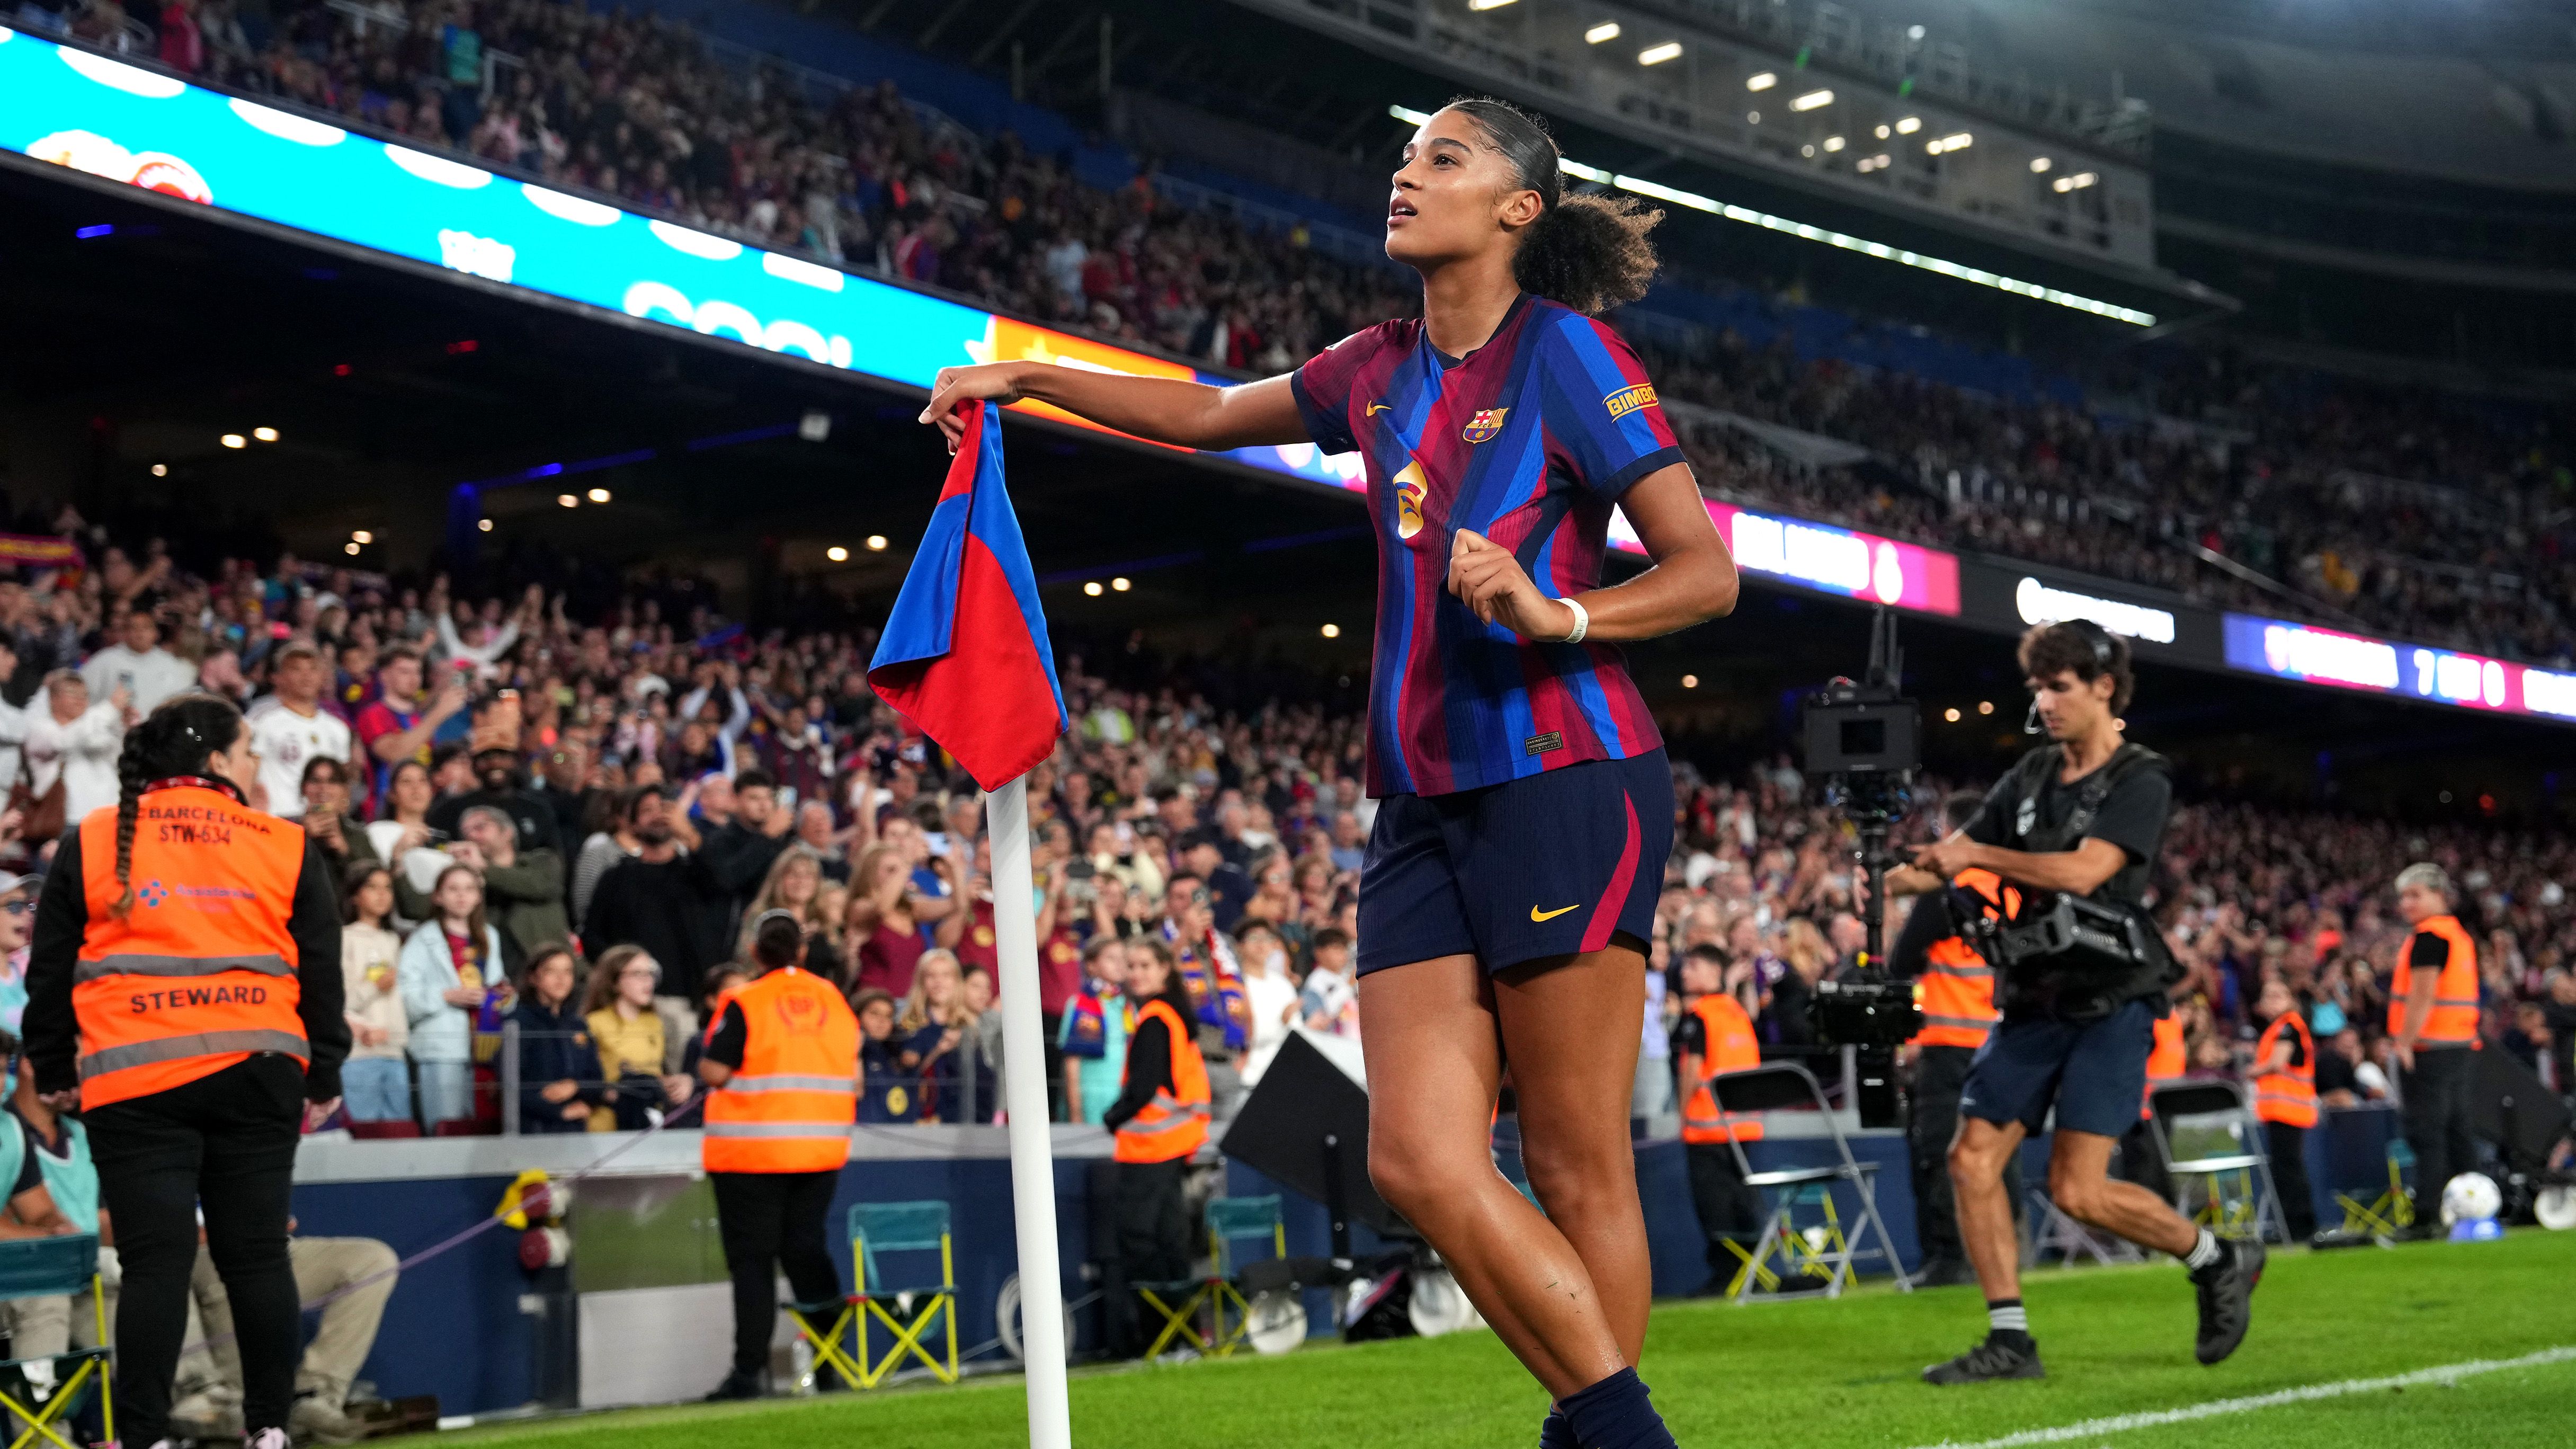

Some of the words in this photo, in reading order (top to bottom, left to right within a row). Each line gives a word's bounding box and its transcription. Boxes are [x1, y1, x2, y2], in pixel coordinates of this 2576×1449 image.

[1606, 386, 1657, 416] BIMBO
[160, 824, 231, 845] STW-634
[131, 985, 266, 1014] STEWARD
